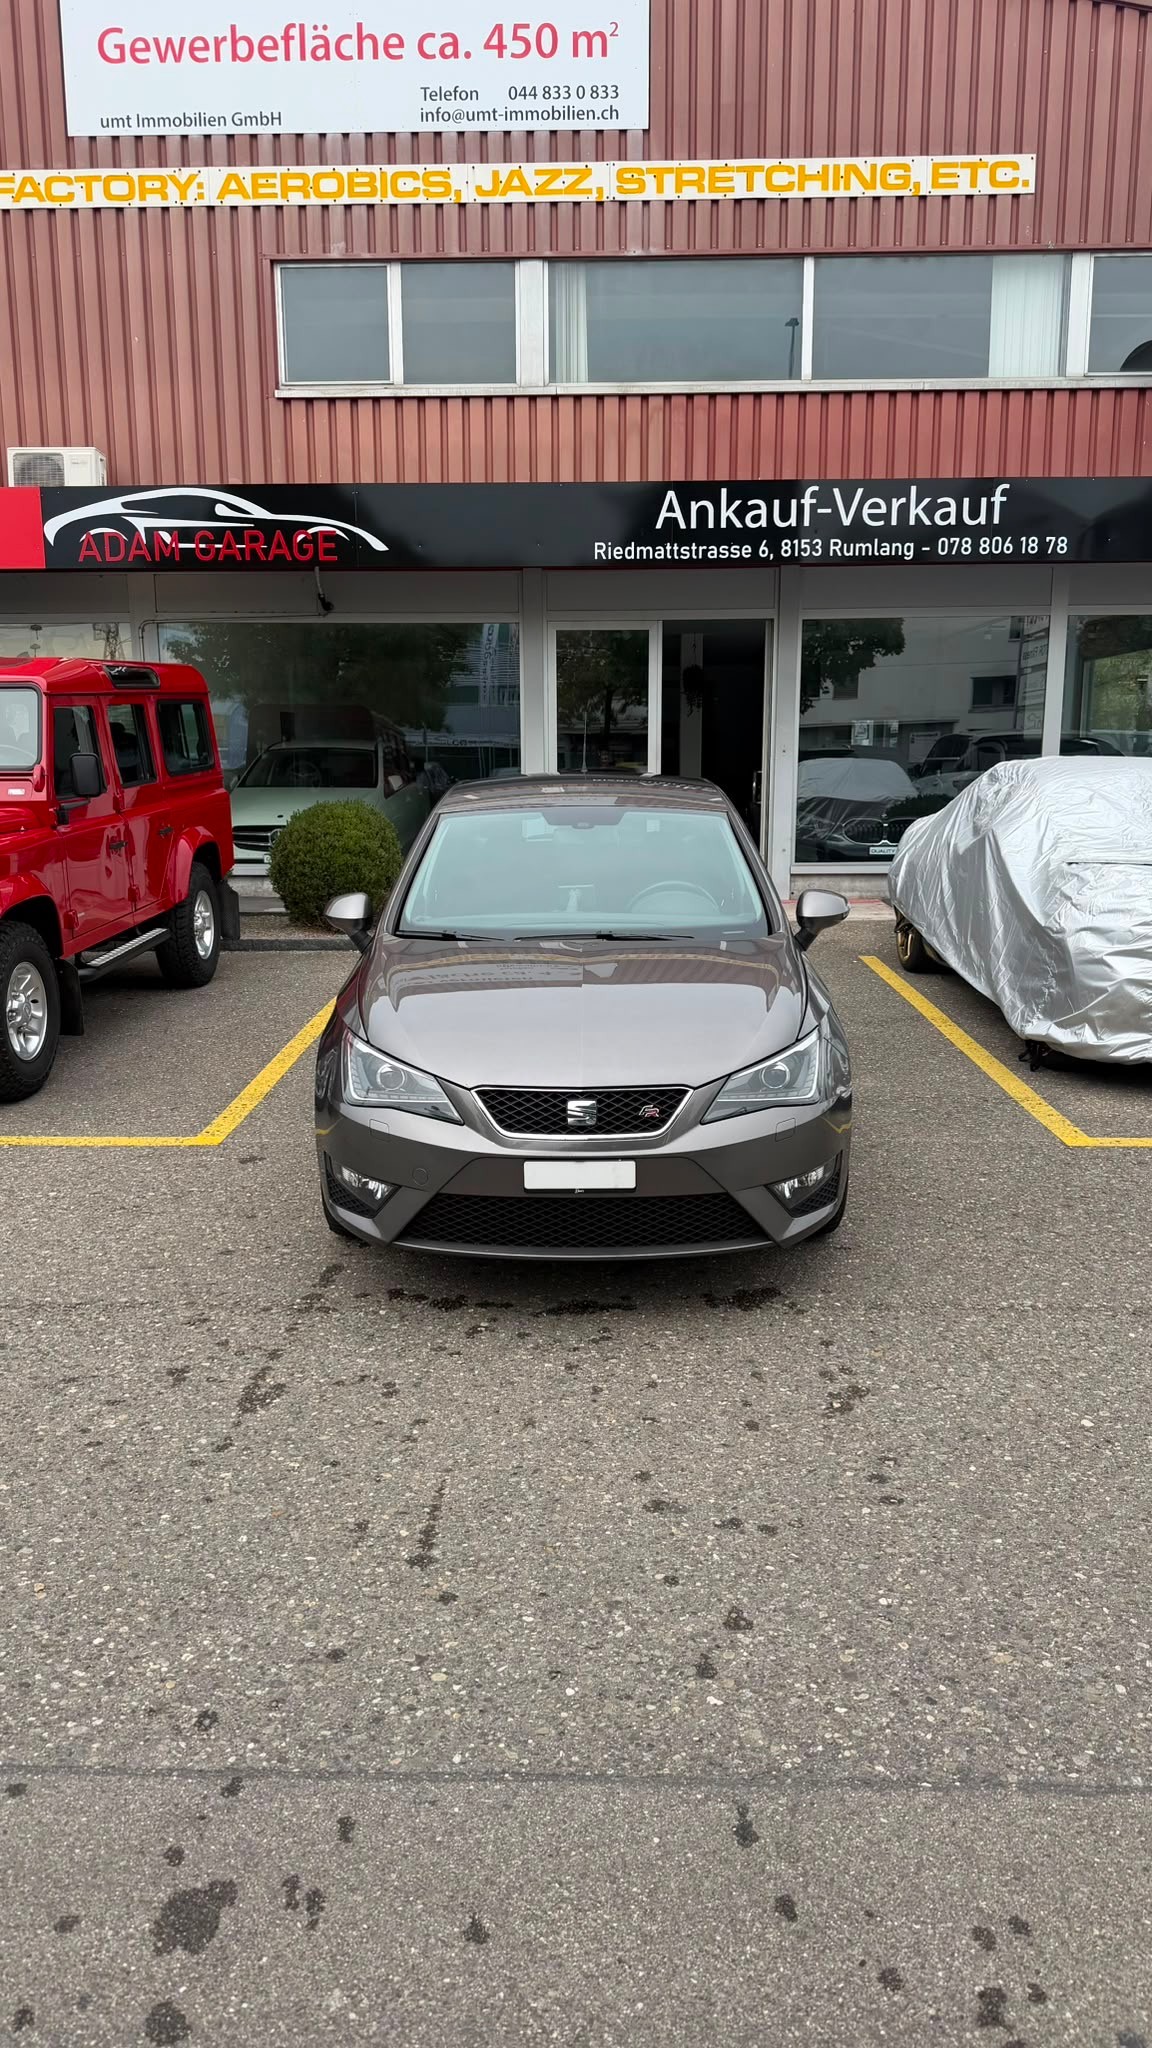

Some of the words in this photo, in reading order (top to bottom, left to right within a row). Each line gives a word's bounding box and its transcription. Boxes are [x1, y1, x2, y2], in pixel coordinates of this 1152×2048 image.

[97, 23, 405, 65] Gewerbefläche
[417, 32, 472, 61] ca.
[484, 23, 559, 60] 450
[420, 85, 479, 102] Telefon
[508, 85, 538, 101] 044
[542, 85, 572, 100] 833
[576, 84, 586, 100] 0
[589, 84, 619, 100] 833
[100, 115, 132, 129] umt
[135, 112, 227, 128] Immobilien
[231, 111, 283, 127] GmbH
[420, 104, 619, 124] info@umt-immobilien.ch
[0, 173, 206, 204] FACTORY:
[216, 170, 463, 205] AEROBICS,
[474, 167, 605, 203] JAZZ,
[615, 162, 922, 198] STRETCHING,
[930, 160, 1030, 191] ETC.
[655, 484, 1011, 530] Ankauf-Verkauf
[79, 530, 181, 563] ADAM
[194, 529, 339, 562] GARAGE
[594, 541, 752, 560] Riedmattstrasse
[758, 539, 774, 561] 6,
[780, 538, 823, 558] 8153
[829, 538, 914, 561] Rumlang
[937, 537, 972, 556] 078
[978, 536, 1014, 555] 806
[1020, 536, 1039, 555] 18
[1045, 536, 1068, 555] 78
